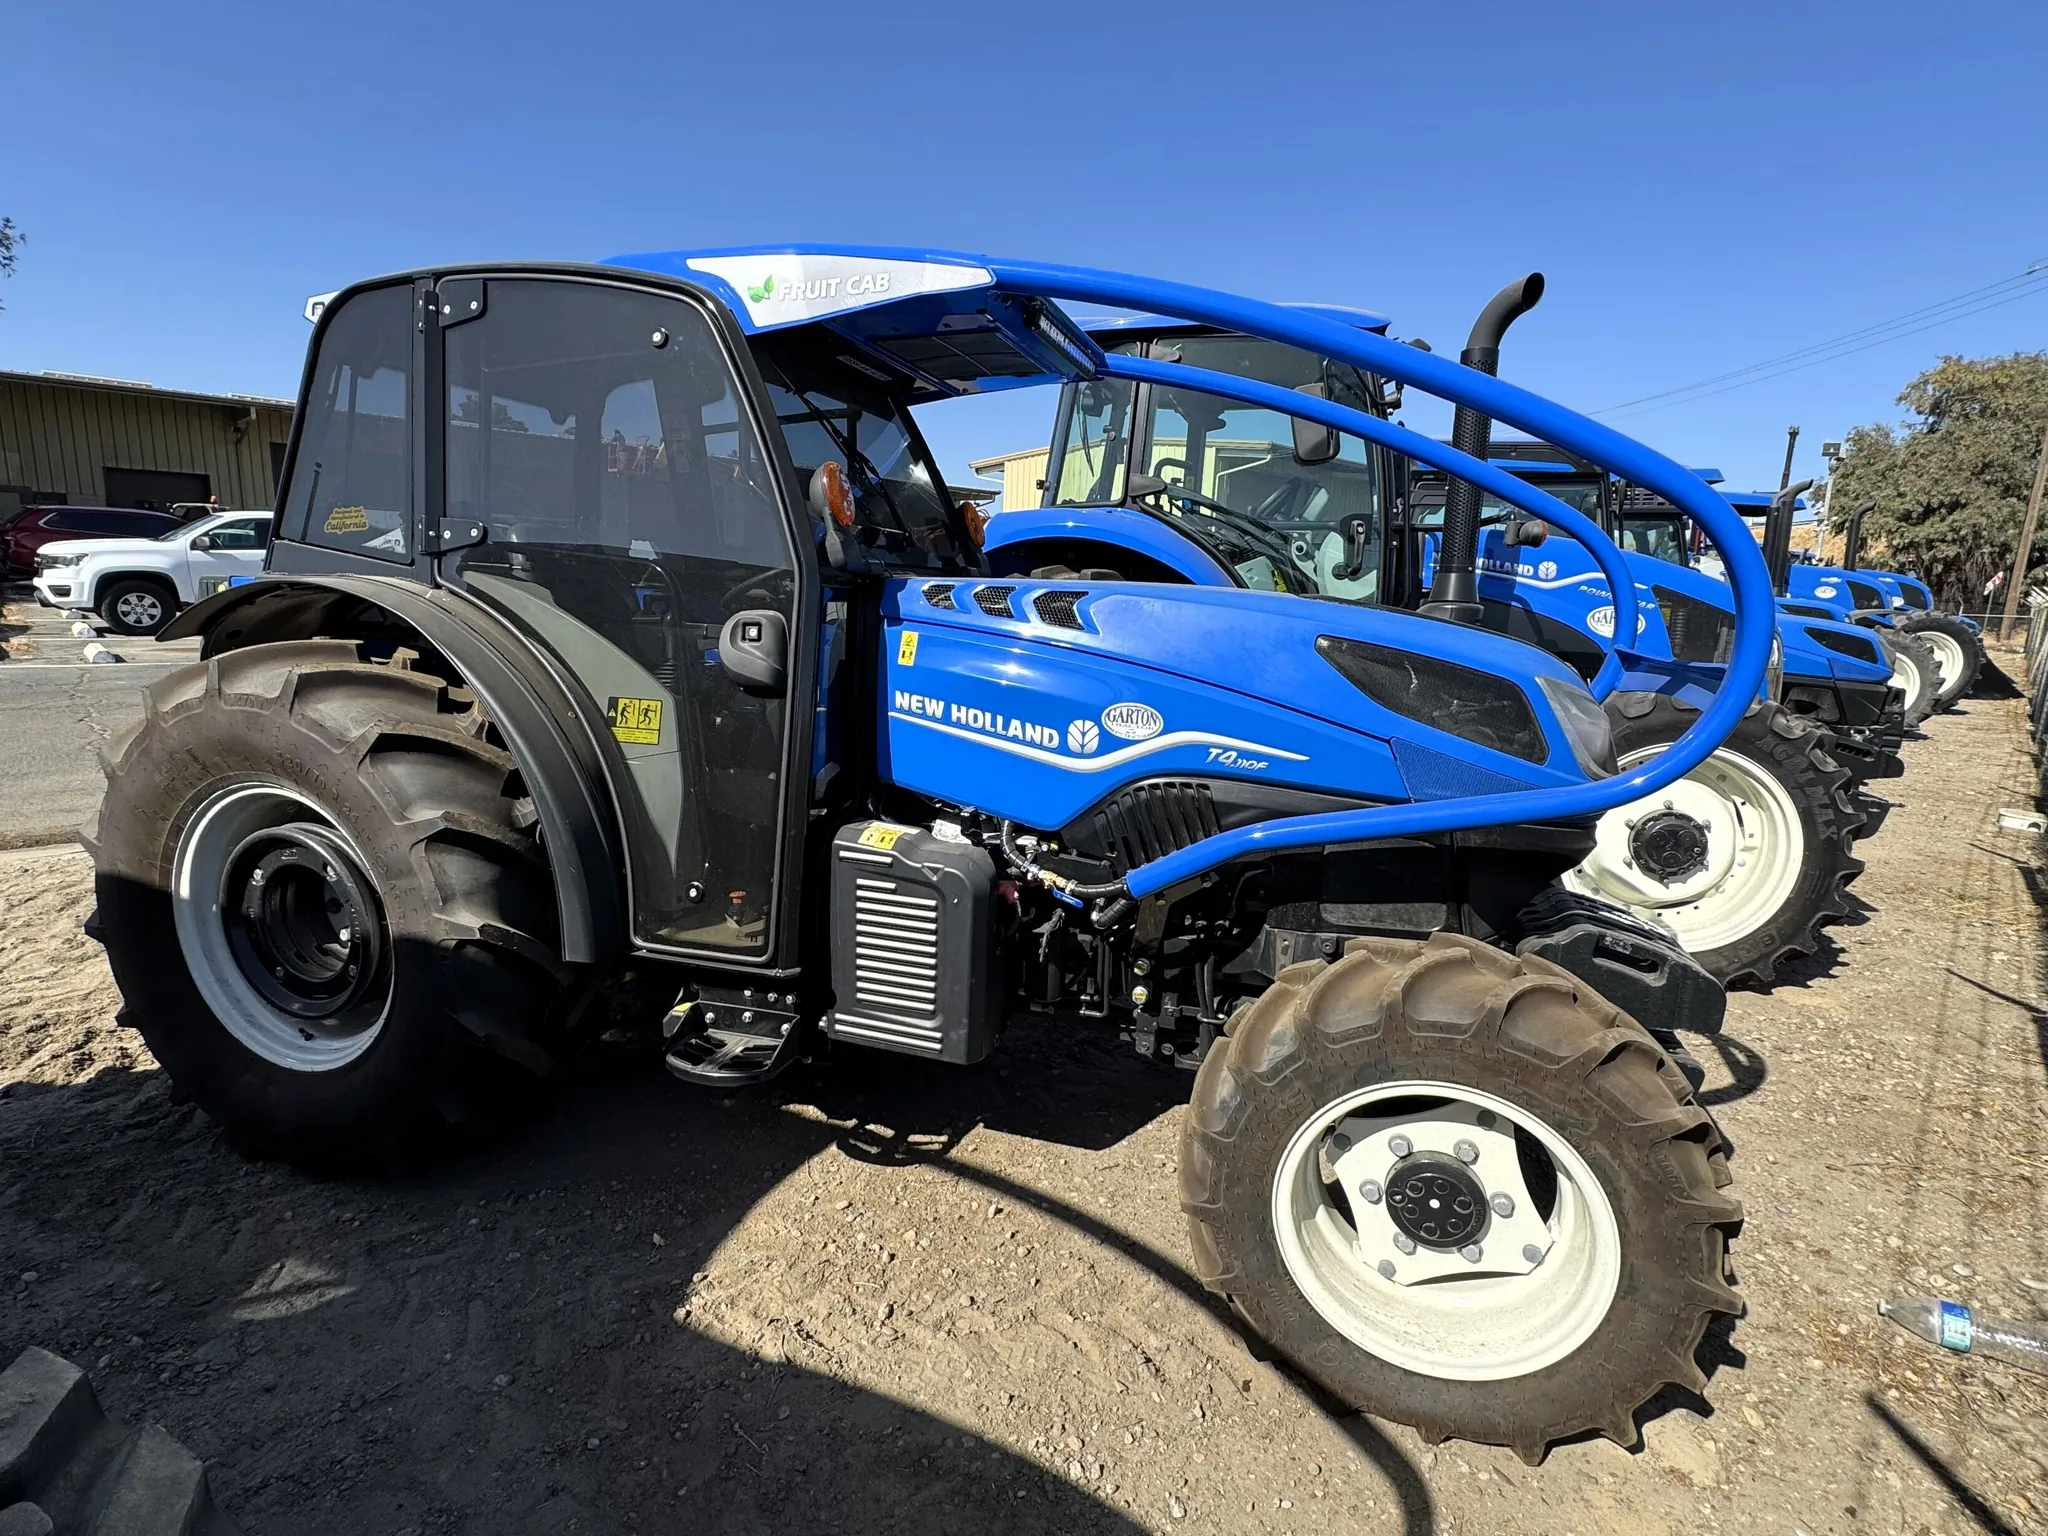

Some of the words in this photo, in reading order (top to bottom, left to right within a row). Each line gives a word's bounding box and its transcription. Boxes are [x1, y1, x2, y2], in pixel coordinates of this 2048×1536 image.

[778, 277, 842, 302] FRUIT
[846, 272, 892, 296] CAB
[326, 519, 367, 532] California
[1476, 557, 1534, 577] OLLAND
[894, 690, 946, 720] NEW
[951, 703, 1061, 750] HOLLAND
[1107, 705, 1159, 728] GARTON
